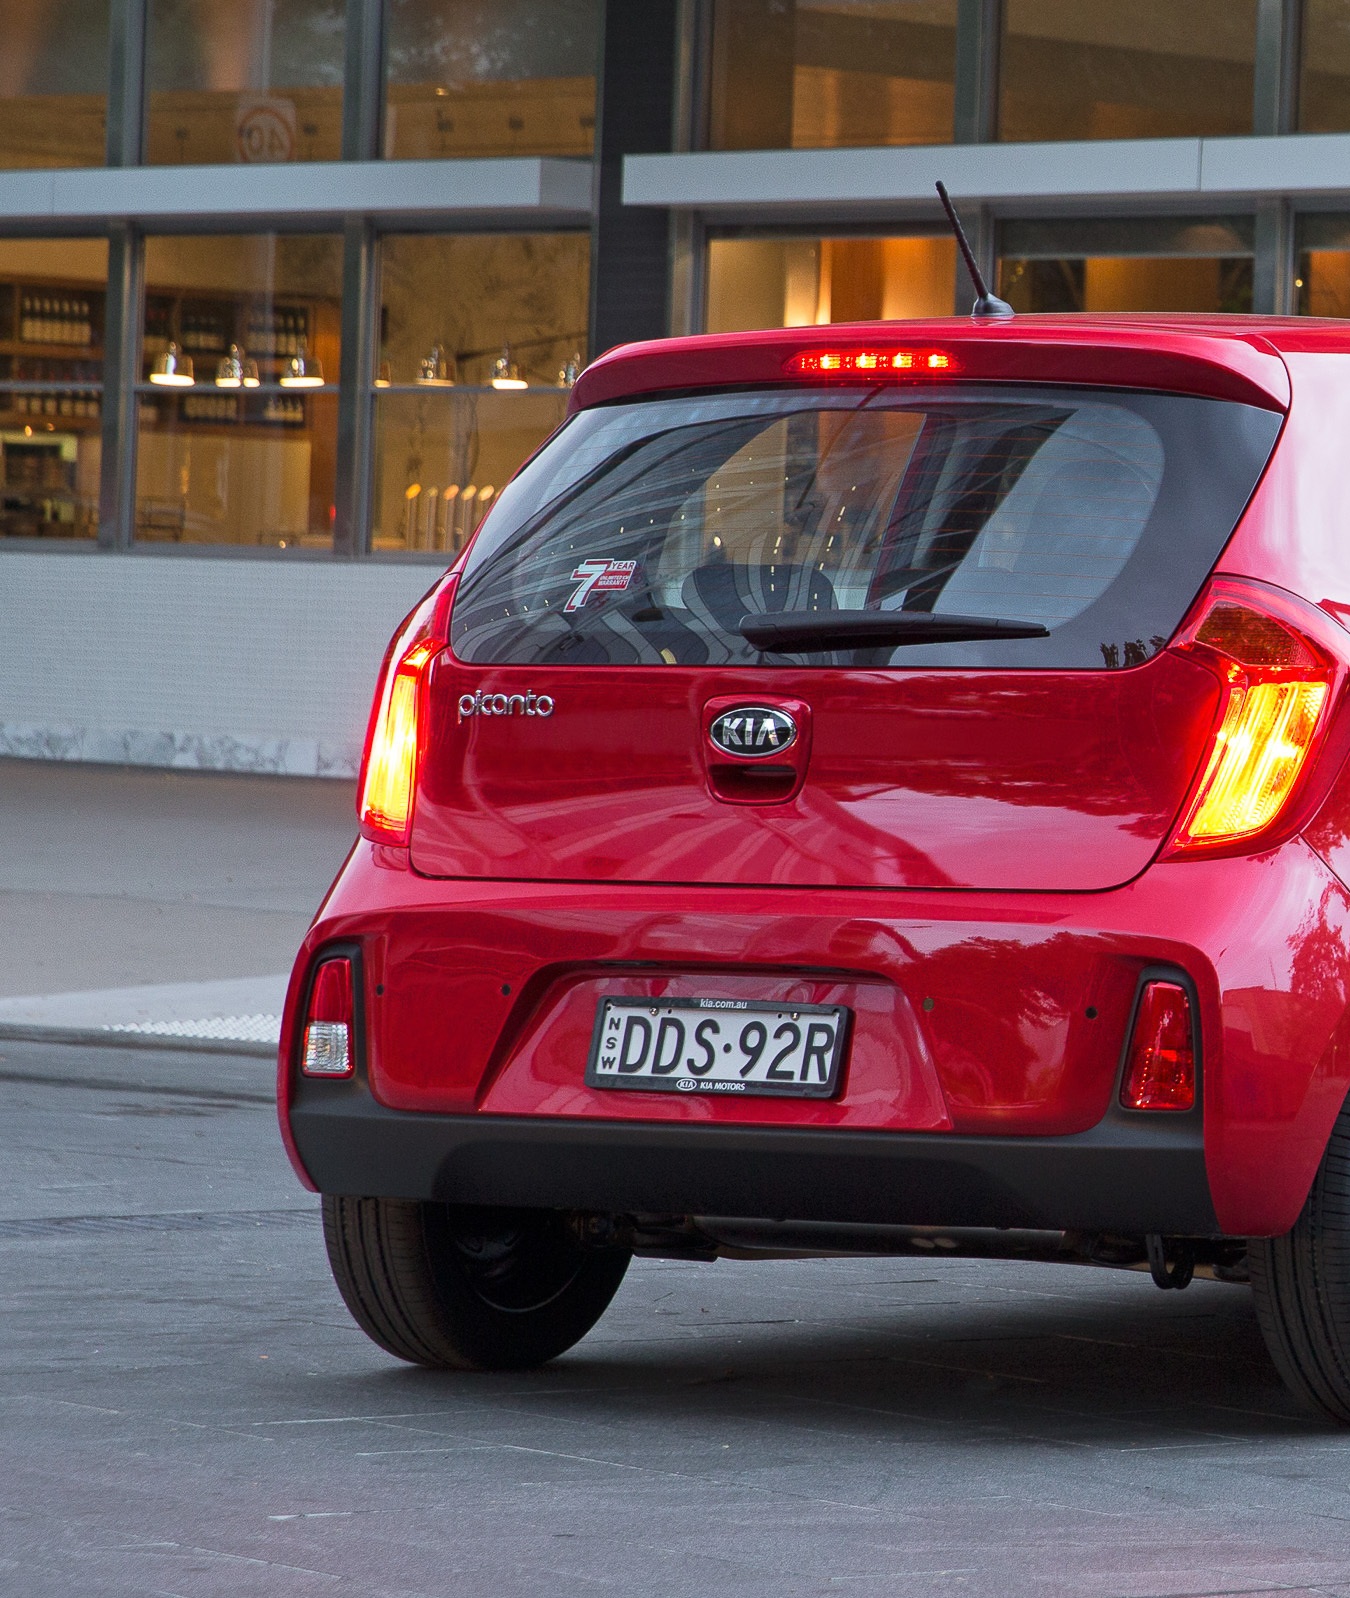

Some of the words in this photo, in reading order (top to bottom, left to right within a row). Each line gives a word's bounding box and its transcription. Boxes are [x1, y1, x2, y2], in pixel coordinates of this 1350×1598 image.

[567, 561, 611, 609] 7
[612, 562, 635, 570] YEAR
[457, 689, 554, 724] picanto
[722, 717, 780, 746] KIA
[700, 999, 748, 1009] kia.com.au
[714, 1083, 746, 1091] MOTORS
